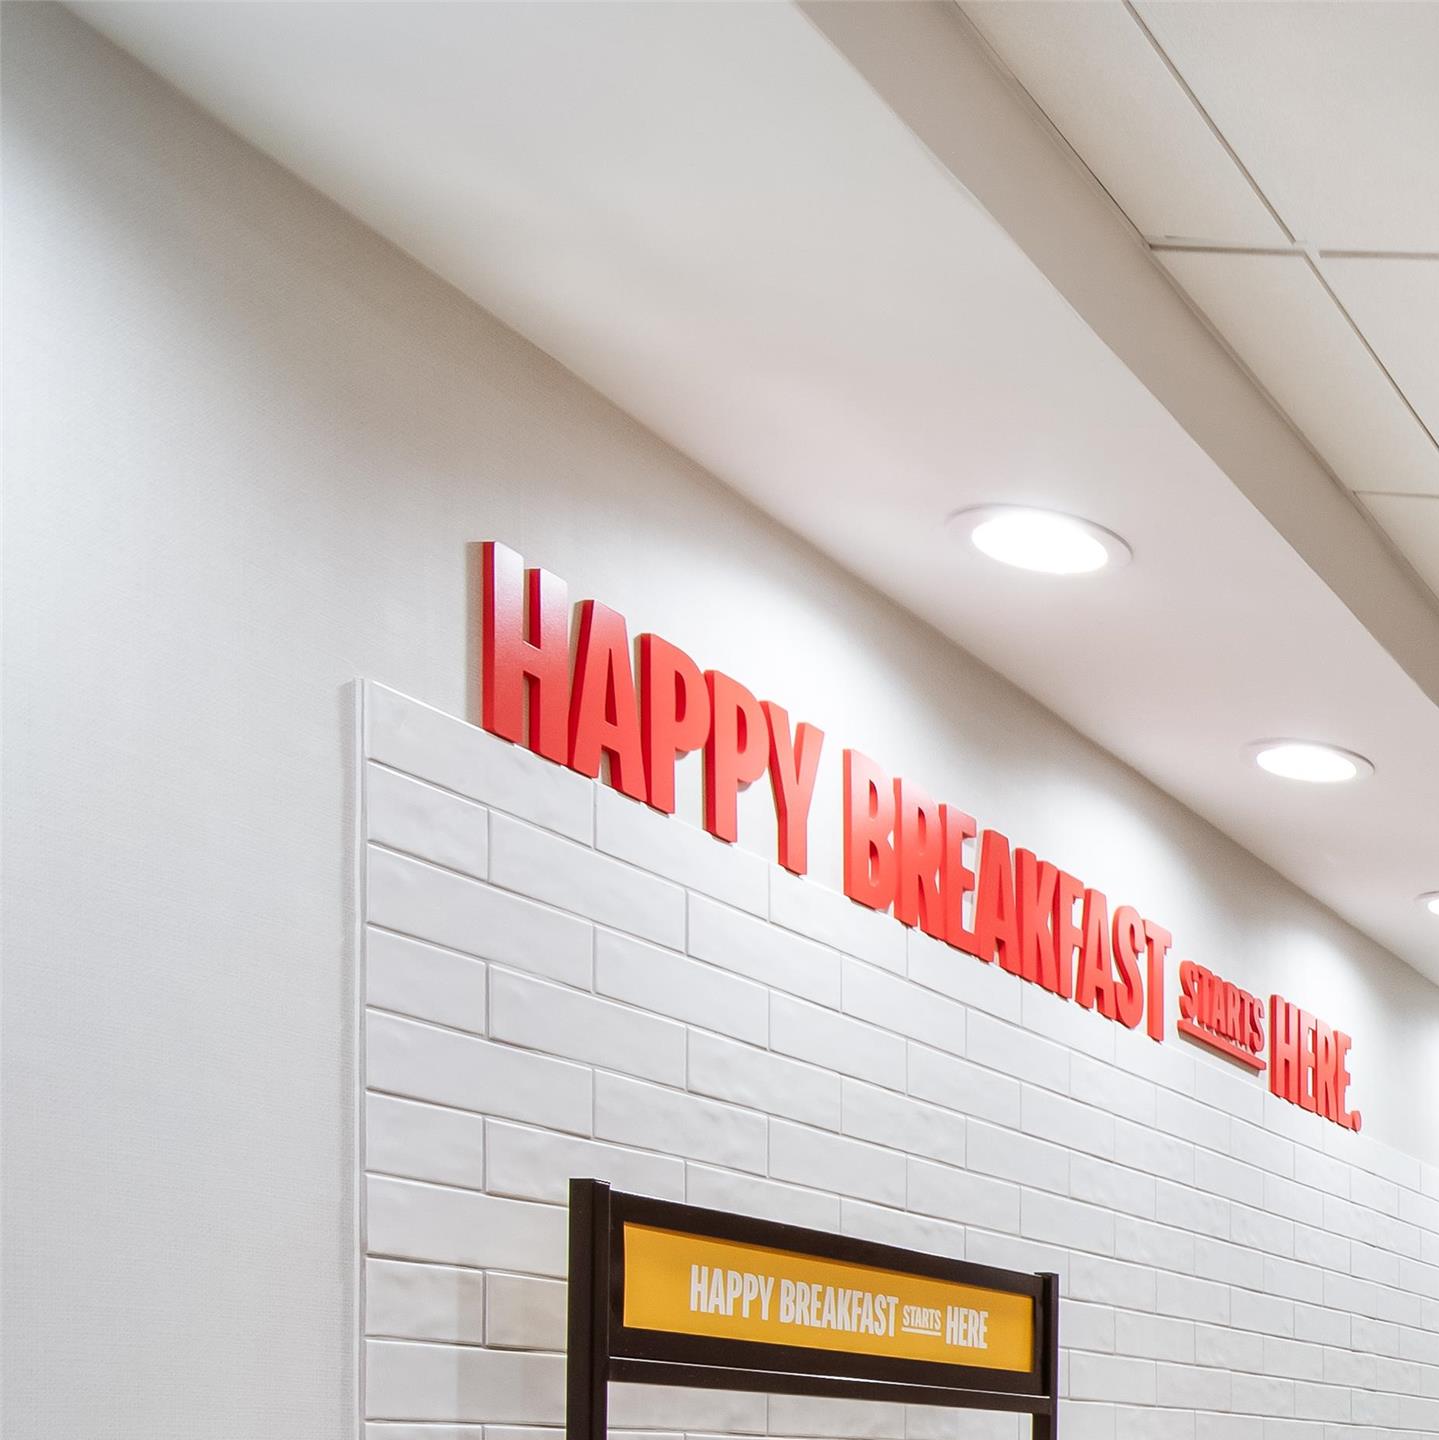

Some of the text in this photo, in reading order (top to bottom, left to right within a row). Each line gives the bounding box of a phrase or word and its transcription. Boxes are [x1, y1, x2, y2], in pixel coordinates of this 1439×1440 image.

[482, 541, 825, 876] HAPPY
[843, 748, 1172, 1043] BREAKFAST
[1178, 960, 1265, 1055] STARTS
[690, 1264, 989, 1349] HAPPY BREAKFAST STARTS HERE
